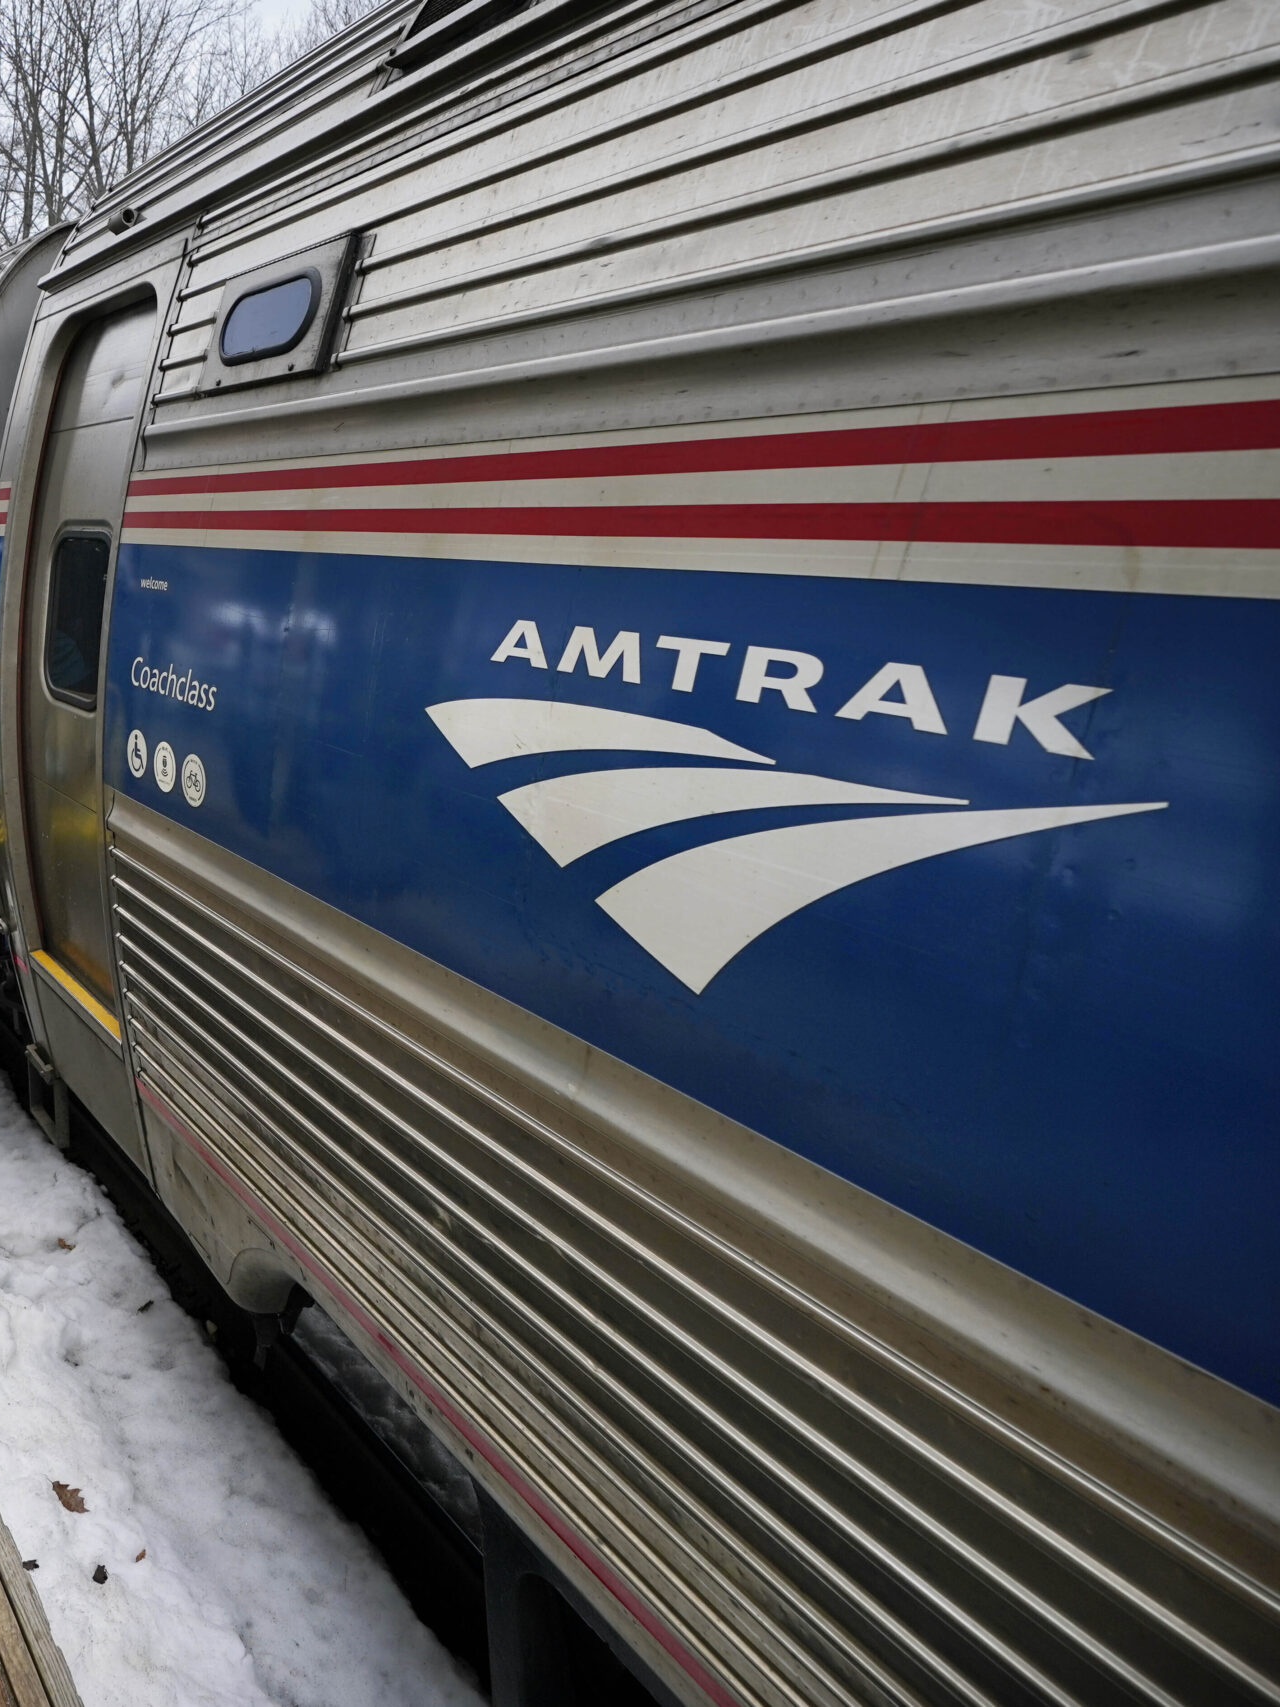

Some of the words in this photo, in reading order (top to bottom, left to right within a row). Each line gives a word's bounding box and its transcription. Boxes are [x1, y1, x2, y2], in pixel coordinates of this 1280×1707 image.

[140, 576, 168, 591] welcome
[131, 656, 217, 712] Coachclass
[490, 619, 1114, 760] AMTRAK
